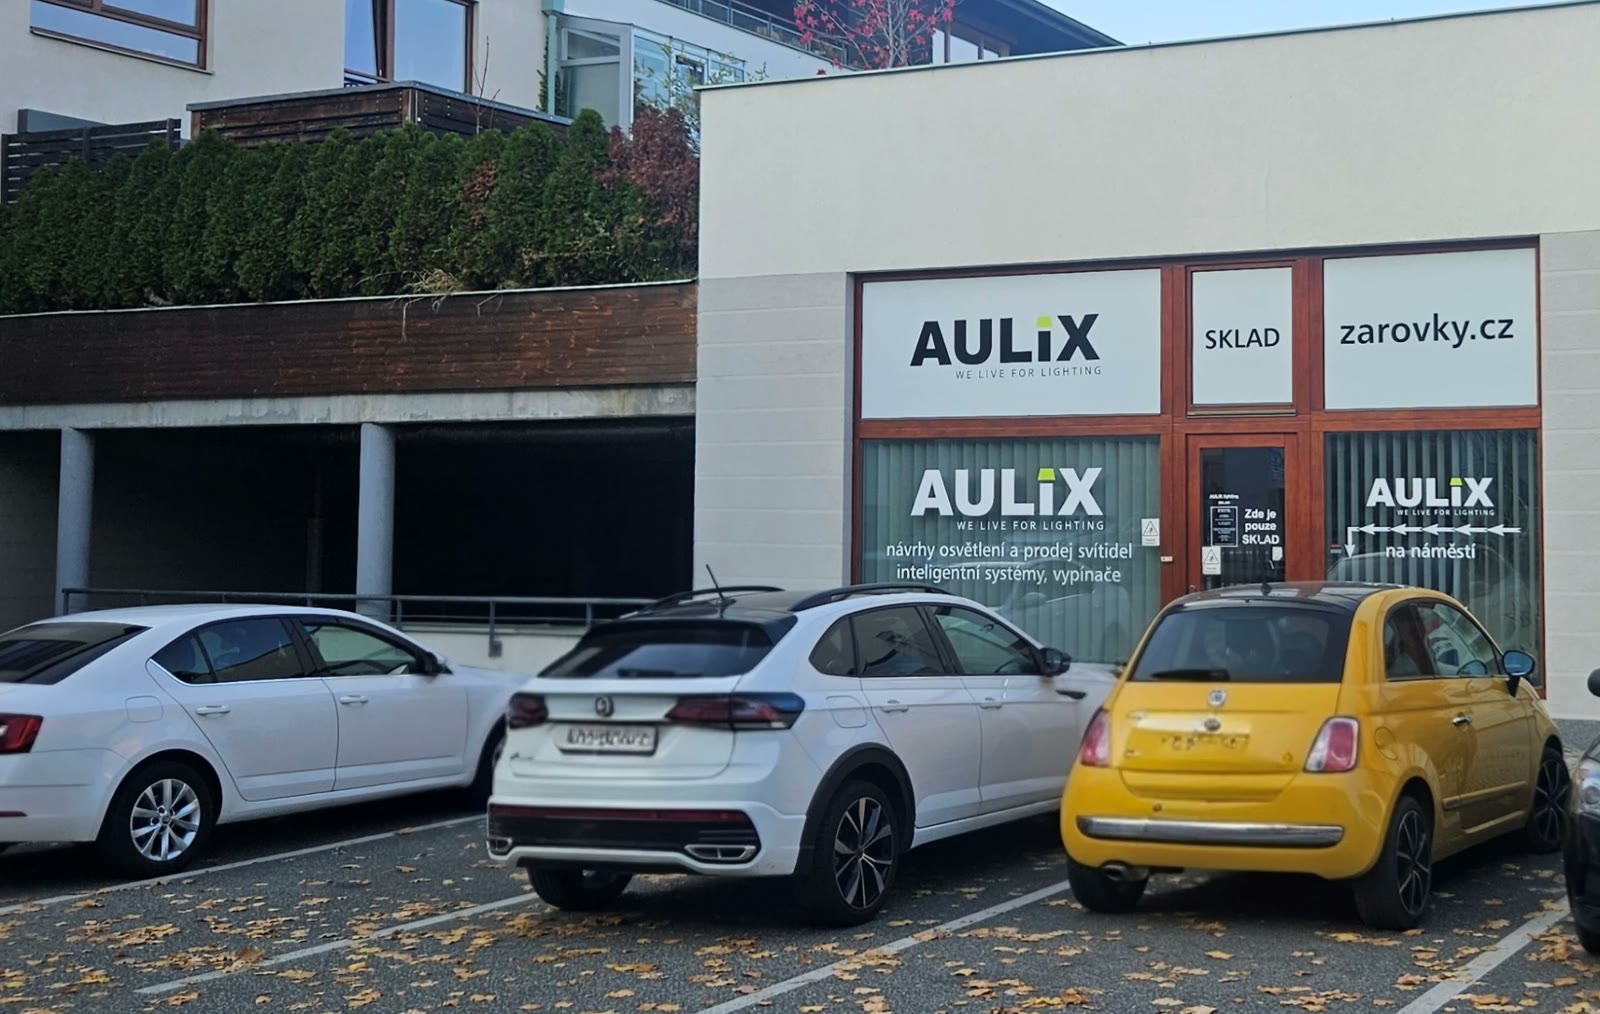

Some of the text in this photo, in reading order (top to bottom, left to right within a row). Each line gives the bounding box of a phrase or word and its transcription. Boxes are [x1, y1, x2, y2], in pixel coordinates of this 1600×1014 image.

[1204, 327, 1280, 349] SKLAD
[1340, 313, 1514, 349] zarovky.cz
[955, 366, 1102, 379] WE LIVE FOR LIGHTING
[1244, 508, 1277, 521] Zde je
[956, 520, 1105, 531] WE LIVE FOR LIGHTING
[1245, 522, 1276, 533] pouze
[1242, 534, 1280, 545] SKLAD
[886, 541, 1132, 562] návrhy osvětlení a prodej svítidel
[1385, 541, 1477, 560] na náměstí
[896, 564, 1121, 586] inteligentní systémy, vypínače
